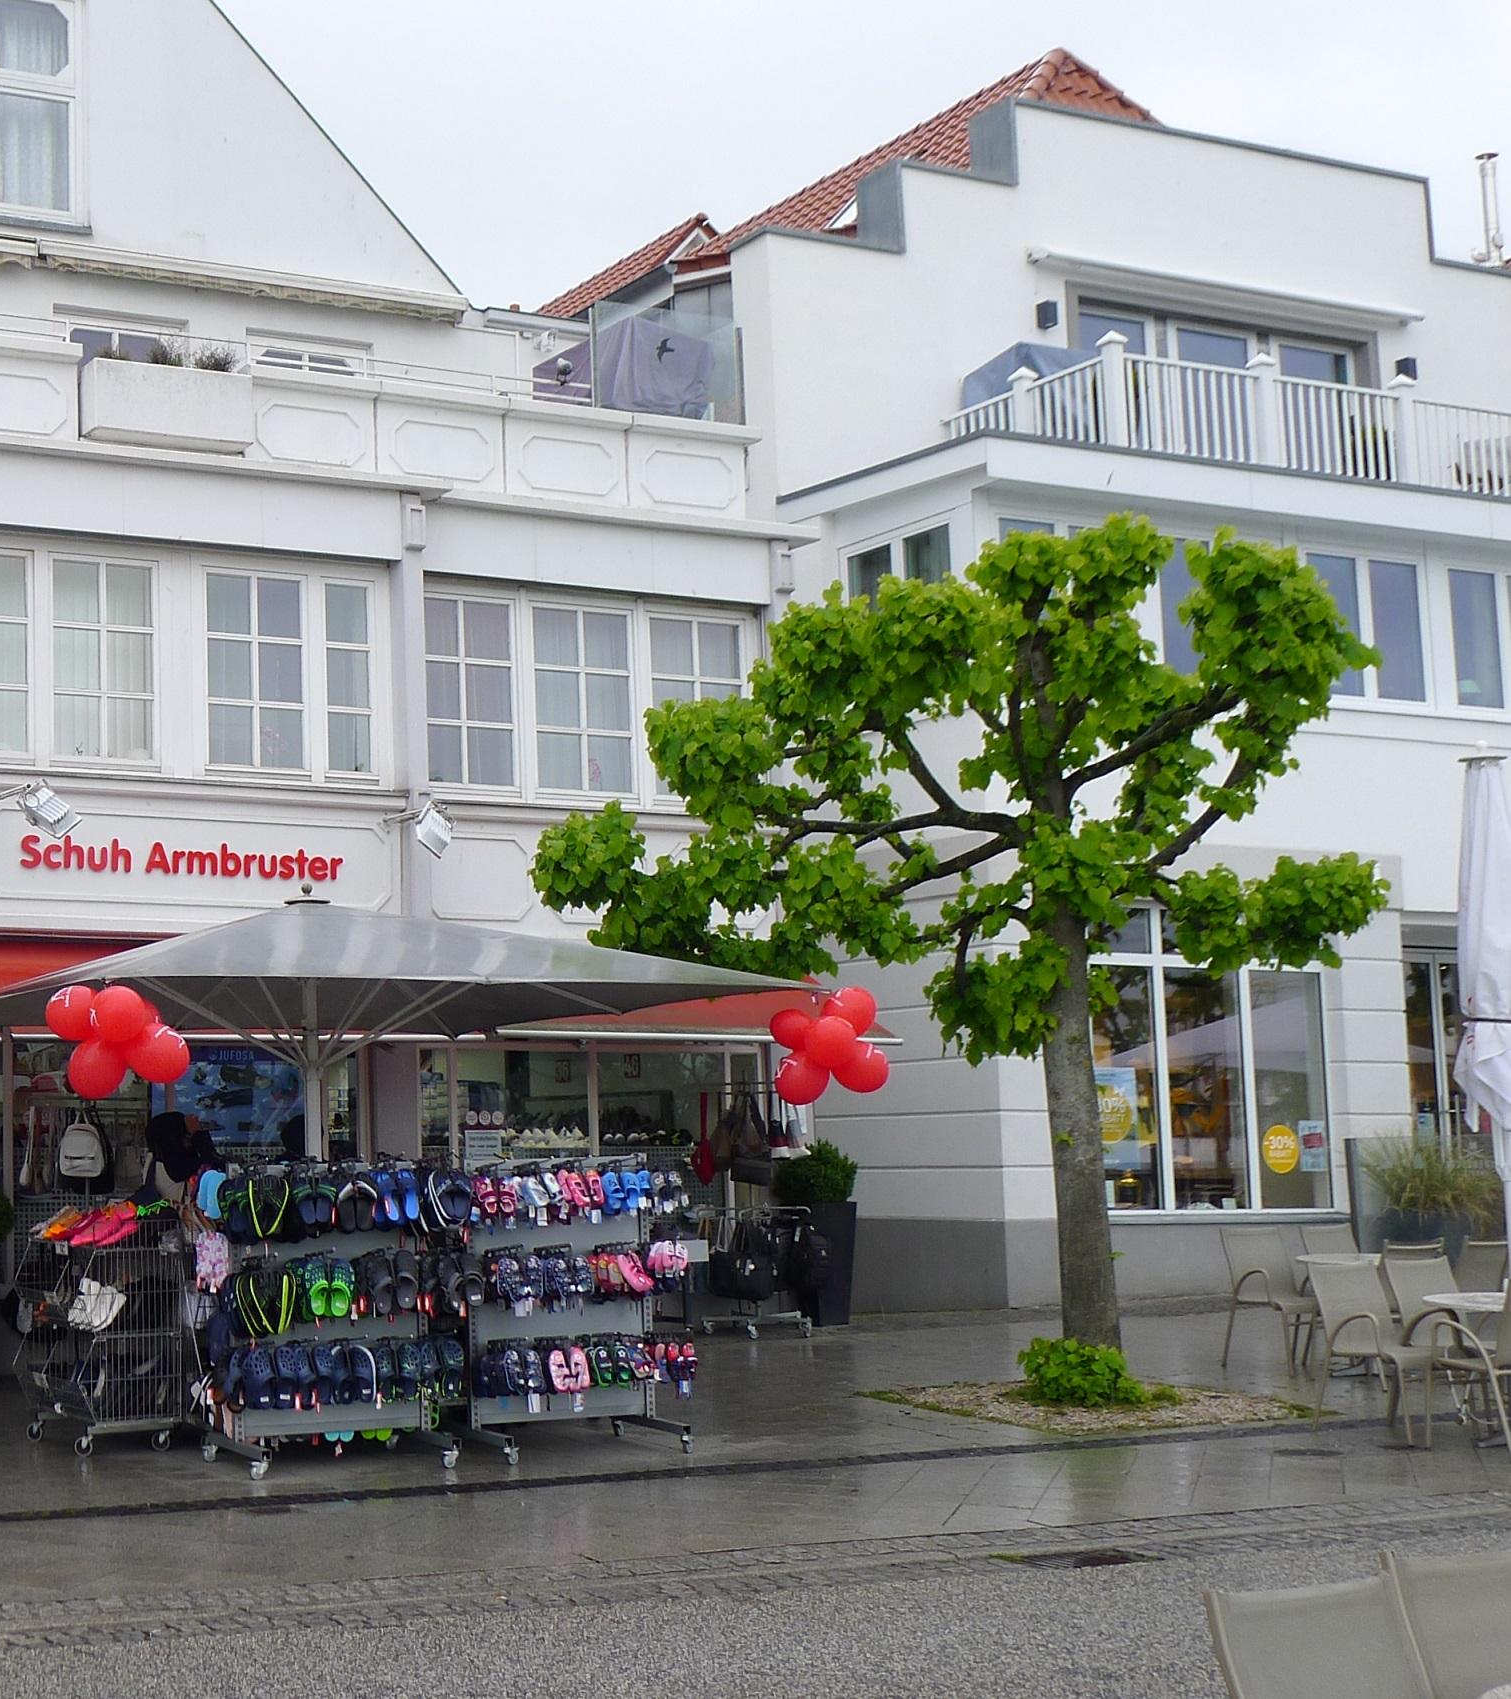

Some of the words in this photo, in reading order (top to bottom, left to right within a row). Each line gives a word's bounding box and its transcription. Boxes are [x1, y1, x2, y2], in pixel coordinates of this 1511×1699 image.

[19, 834, 132, 873] Schuh
[145, 841, 344, 881] Armbruster
[1264, 1135, 1296, 1150] -30%
